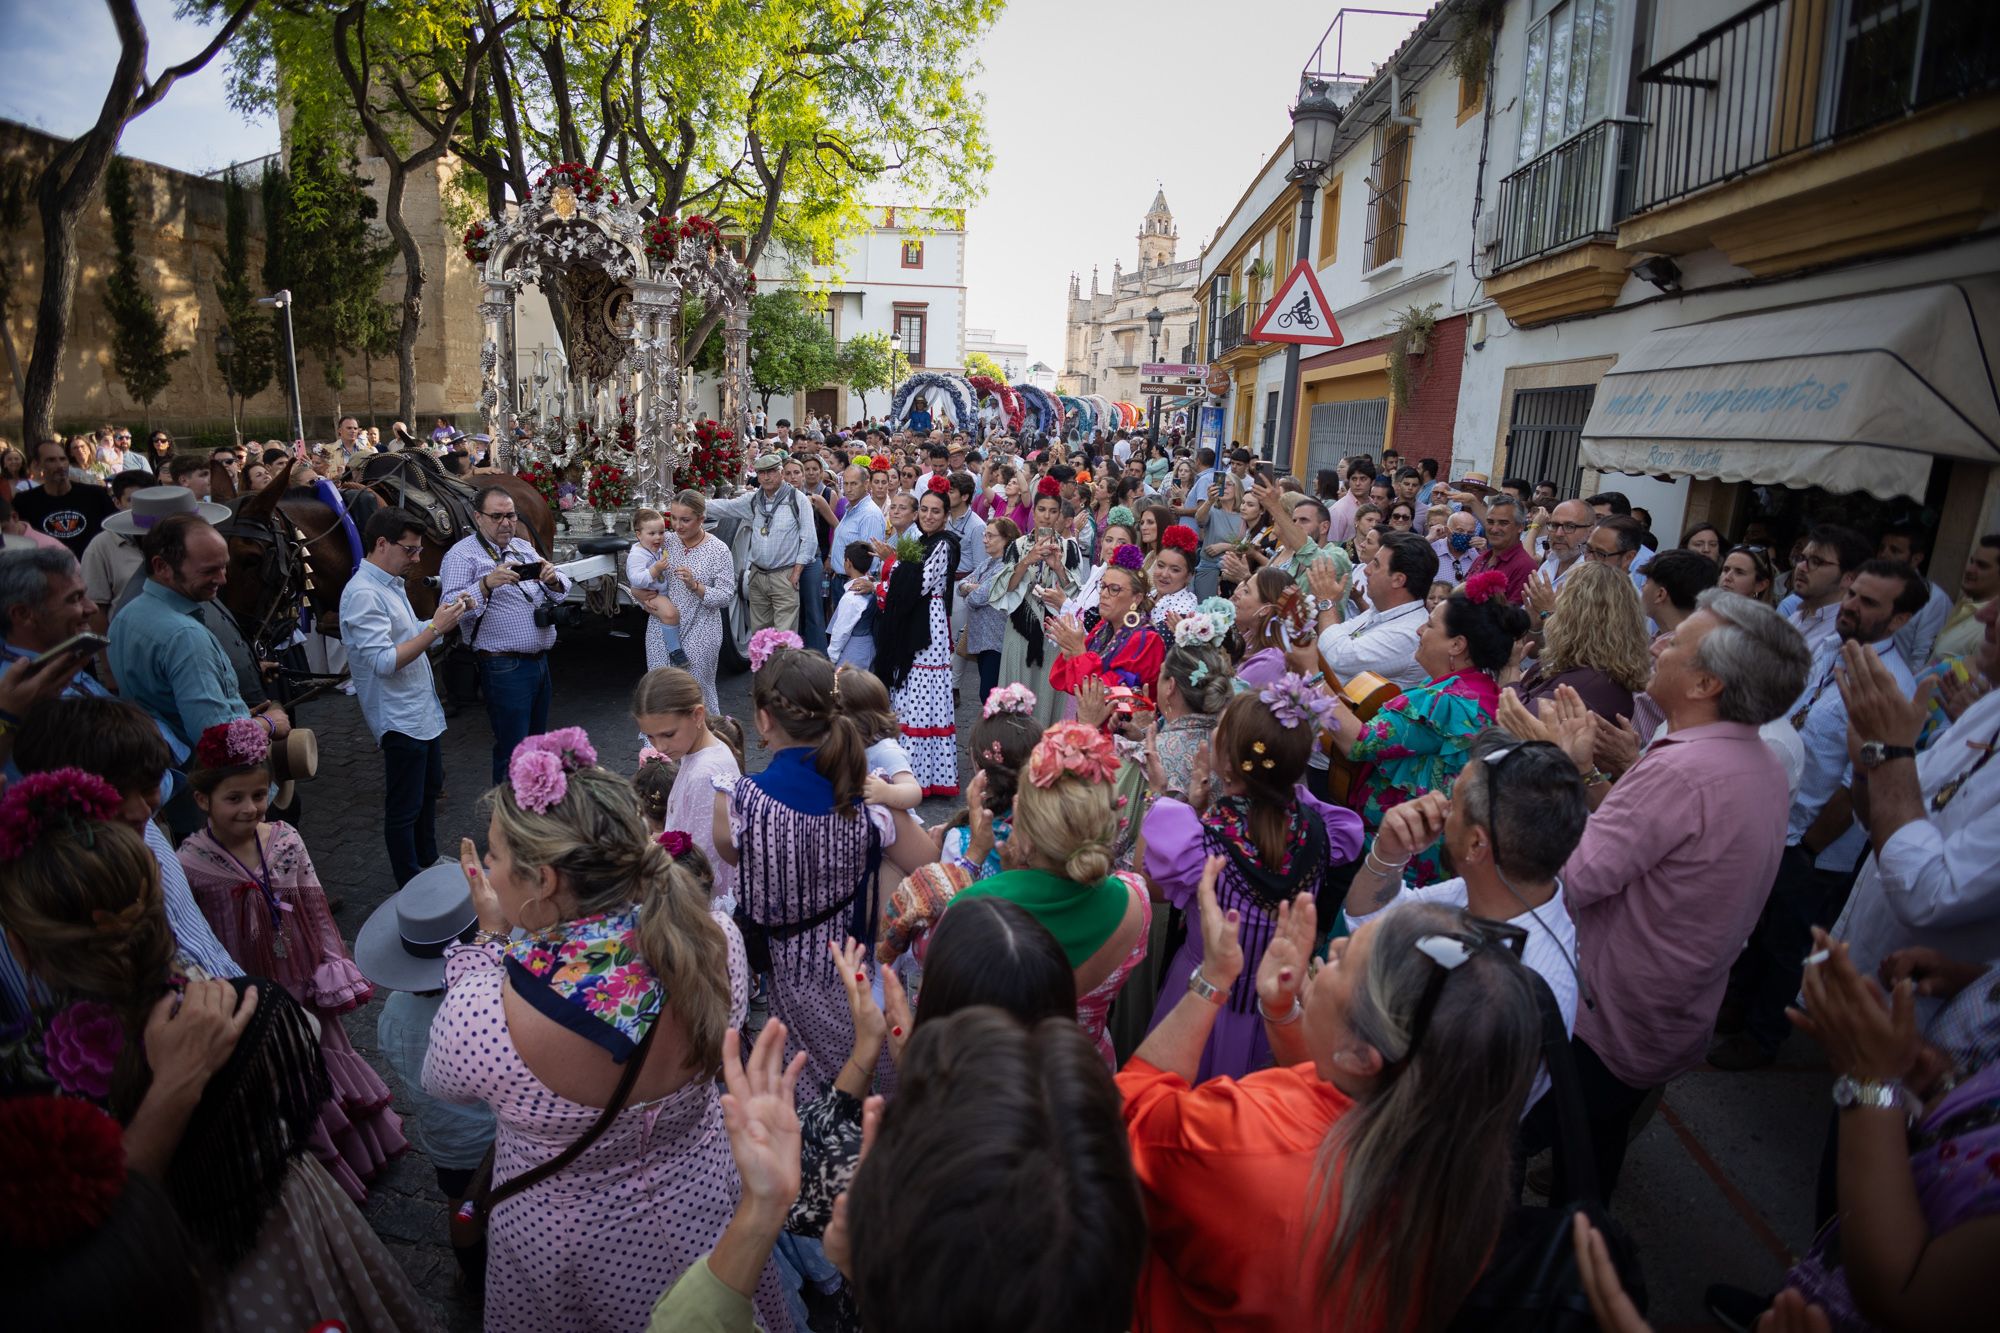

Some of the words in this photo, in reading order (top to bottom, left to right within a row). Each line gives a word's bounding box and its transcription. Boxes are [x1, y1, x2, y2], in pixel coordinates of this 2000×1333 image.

[1604, 387, 1648, 416] moda
[1648, 394, 1672, 427] y
[1675, 374, 1849, 423] complementos
